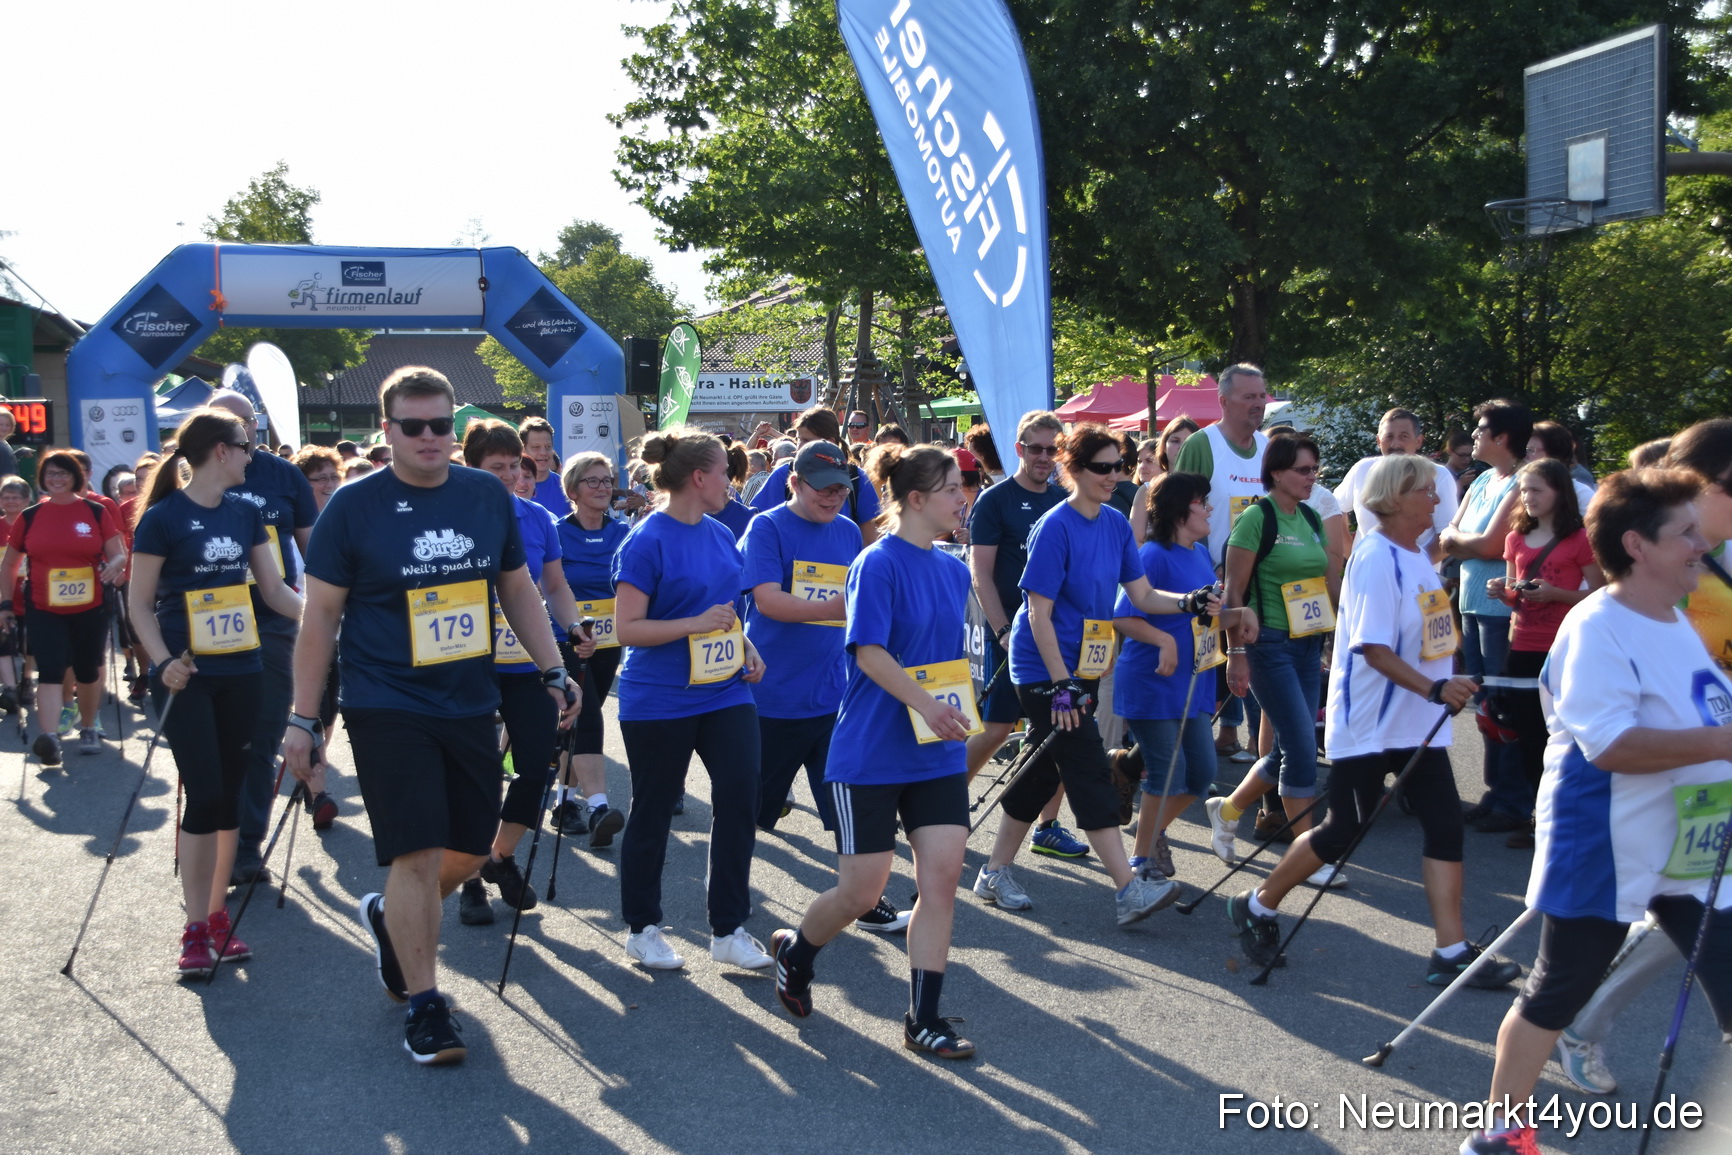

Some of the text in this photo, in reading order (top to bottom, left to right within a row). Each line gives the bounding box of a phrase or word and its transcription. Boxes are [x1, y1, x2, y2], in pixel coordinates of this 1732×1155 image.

[351, 270, 384, 279] Fischer
[326, 287, 424, 305] firmenlauf
[135, 320, 191, 332] Fischer
[675, 366, 696, 397] AOK
[204, 541, 243, 562] Burgis
[414, 533, 474, 561] Burgis
[195, 564, 219, 573] Weil's
[221, 561, 242, 573] guad
[402, 555, 491, 576] Weil's guad is!
[59, 582, 86, 596] 202
[1302, 600, 1321, 621] 26
[206, 612, 245, 637] 176
[429, 613, 475, 642] 179
[595, 618, 614, 636] 56
[1427, 614, 1452, 641] 1098
[495, 628, 520, 647] 75
[702, 639, 735, 665] 720
[1087, 644, 1107, 664] 753
